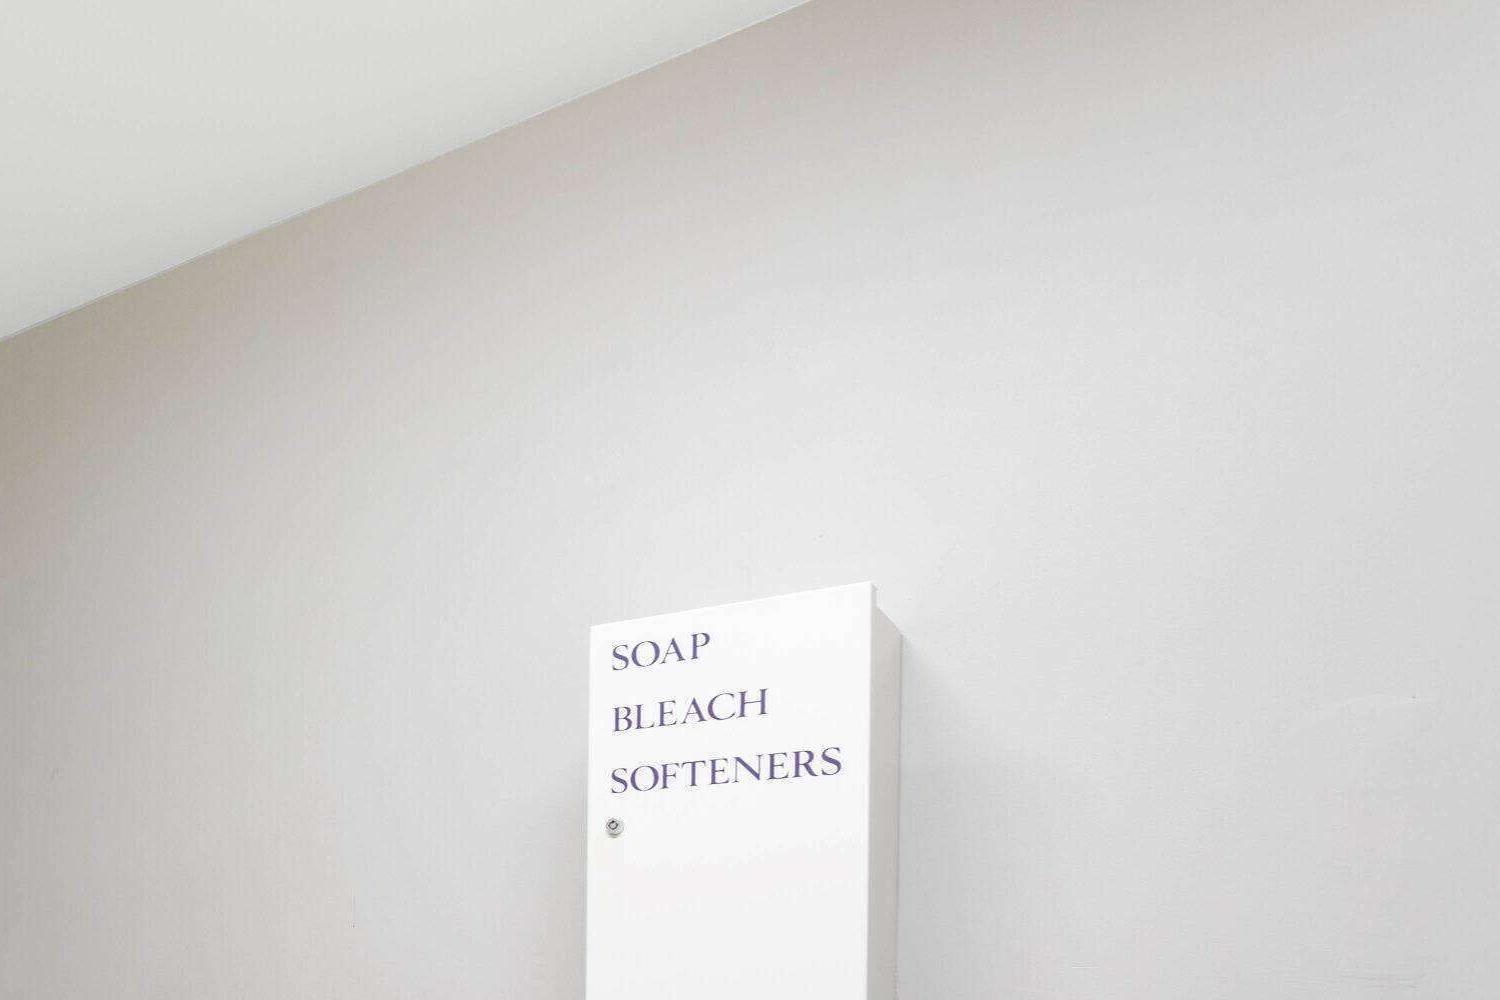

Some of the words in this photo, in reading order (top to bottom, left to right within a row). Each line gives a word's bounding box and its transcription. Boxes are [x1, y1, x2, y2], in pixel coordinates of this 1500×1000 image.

[612, 632, 710, 671] SOAP
[613, 688, 769, 732] BLEACH
[611, 747, 842, 794] SOFTENERS
